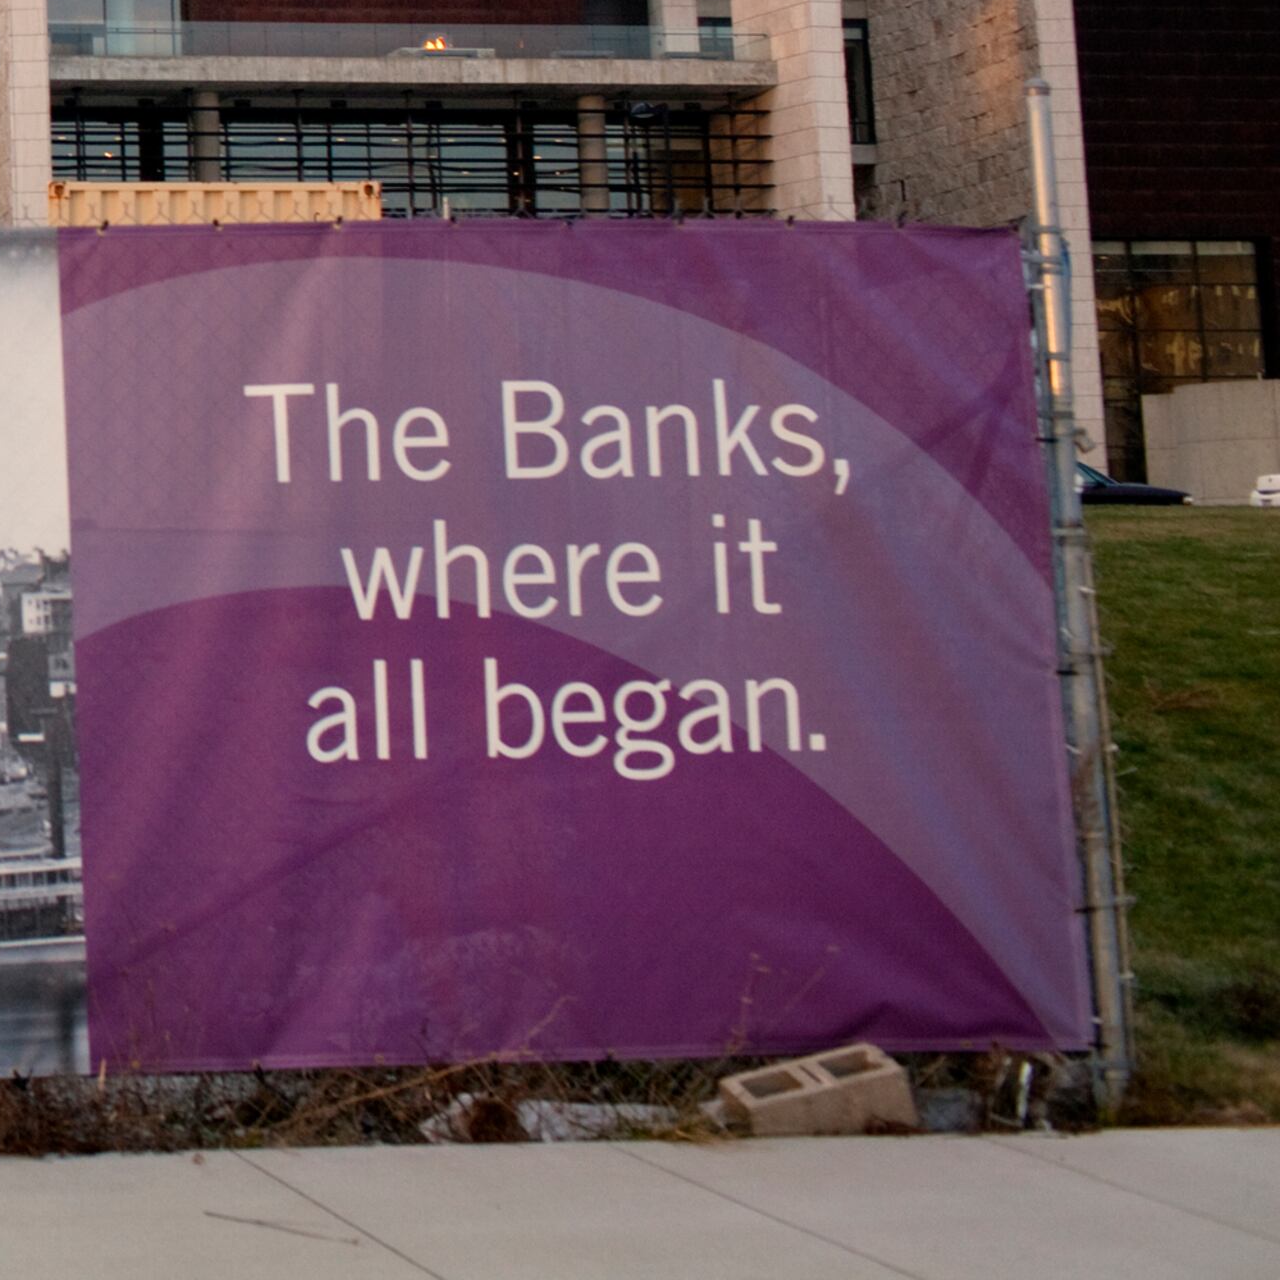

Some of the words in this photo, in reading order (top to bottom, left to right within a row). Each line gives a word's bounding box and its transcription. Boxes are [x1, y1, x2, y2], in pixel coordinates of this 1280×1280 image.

[242, 382, 450, 483] The
[501, 378, 850, 495] Banks,
[341, 519, 663, 620] where
[712, 514, 781, 614] it
[307, 659, 428, 762] all
[485, 658, 826, 780] began.
